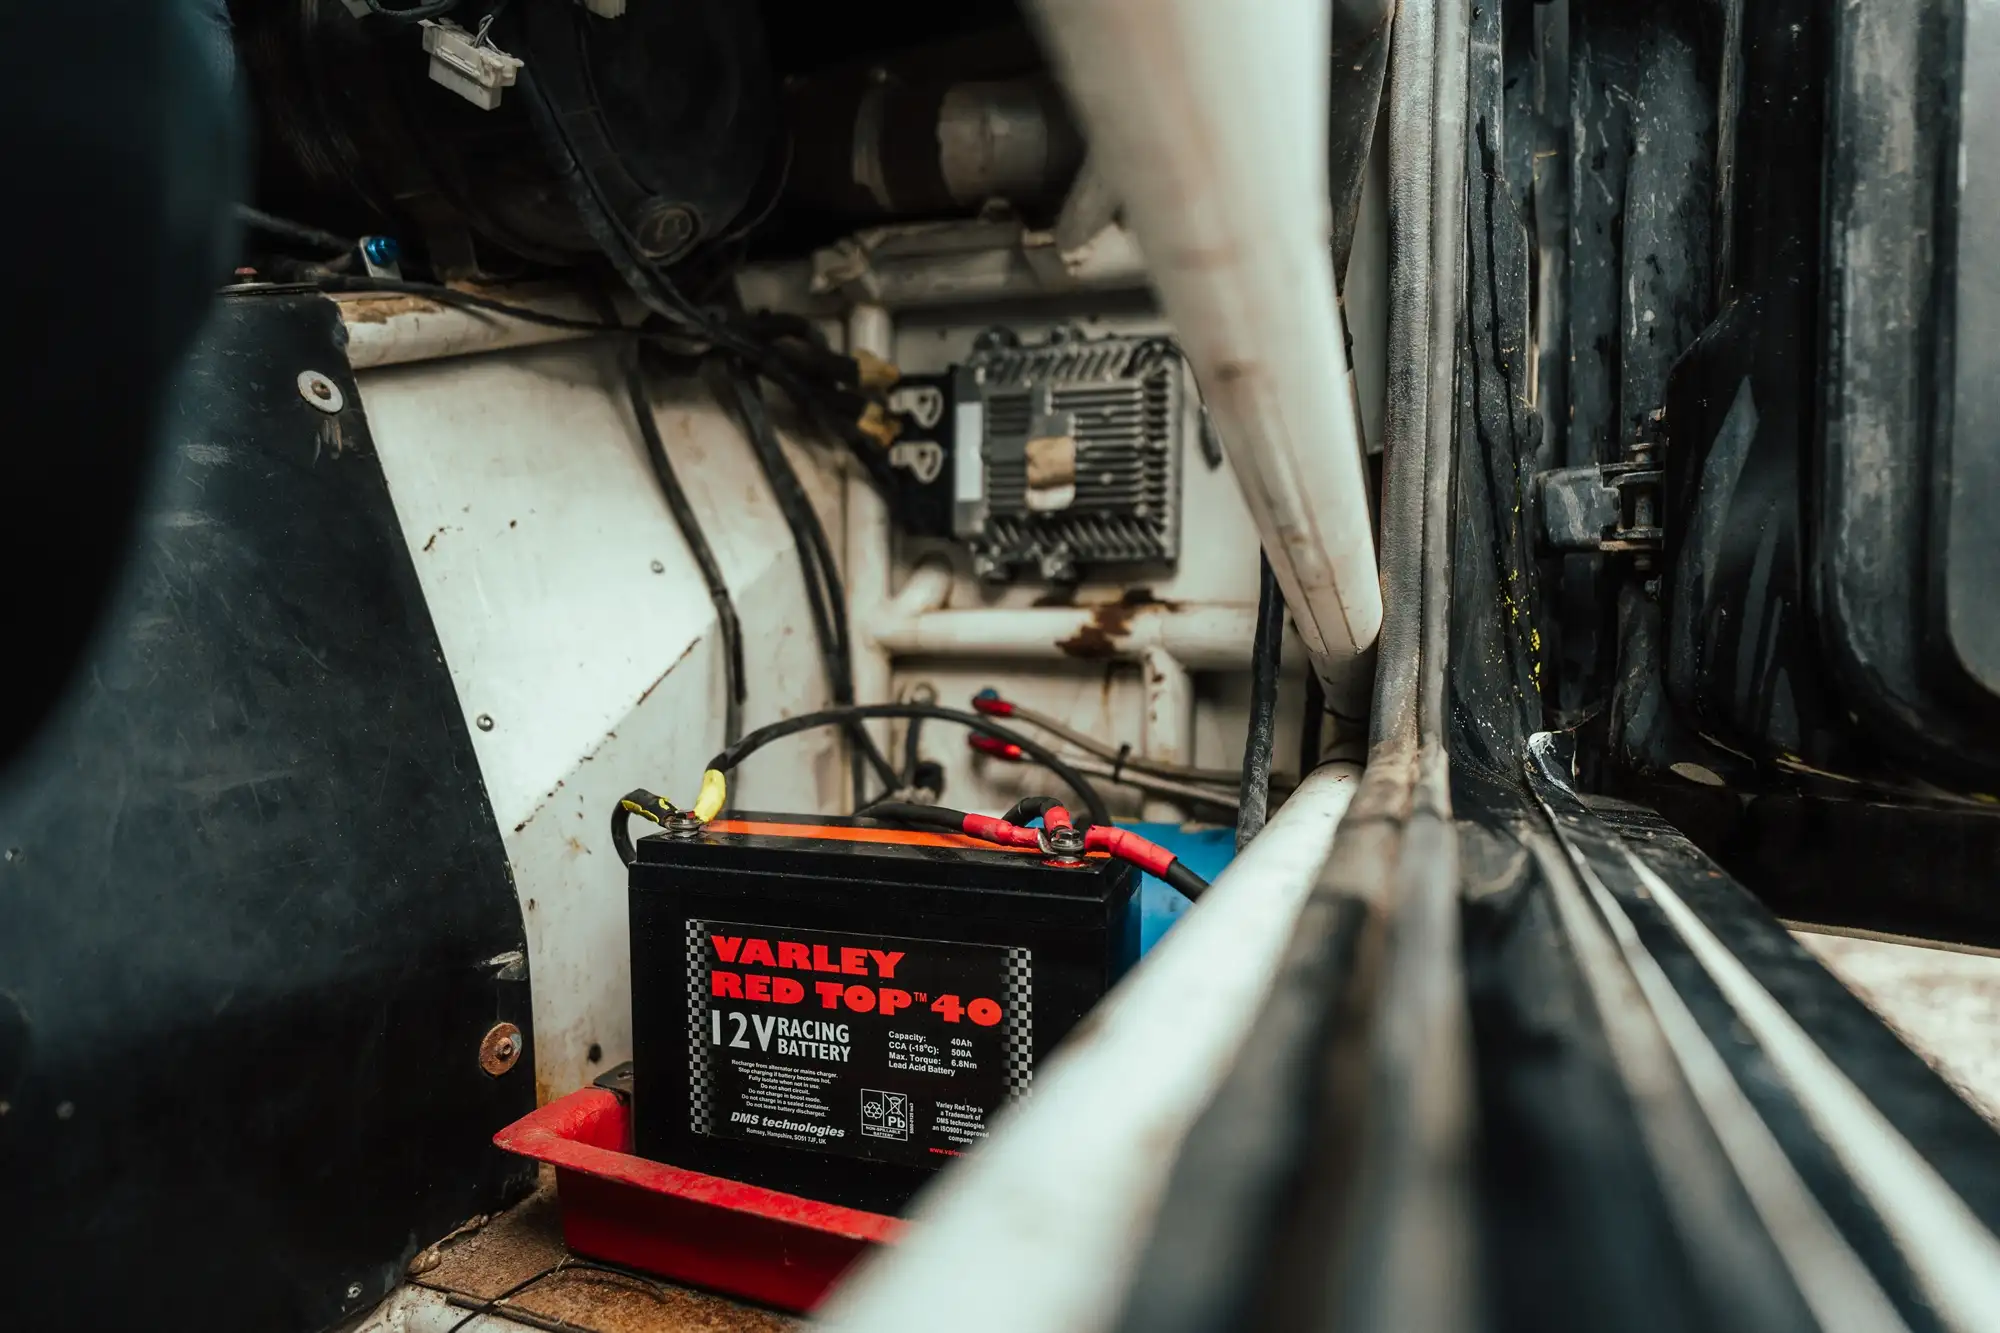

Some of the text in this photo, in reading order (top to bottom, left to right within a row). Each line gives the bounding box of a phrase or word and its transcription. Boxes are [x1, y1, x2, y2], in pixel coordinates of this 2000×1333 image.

[711, 935, 905, 979] VARLEY
[711, 970, 805, 1005] RED
[815, 981, 912, 1015] TOP
[930, 993, 1002, 1026] 40
[712, 1009, 776, 1052] 12V
[777, 1017, 850, 1043] RACING
[888, 1031, 973, 1047] Capacity: 40Ah
[777, 1038, 851, 1062] BATTERY
[888, 1041, 907, 1051] CCA
[951, 1048, 972, 1058] 500A
[731, 1059, 755, 1069] Recharge
[768, 1064, 793, 1072] alternator
[888, 1051, 978, 1069] Max. Torque: 6.8Nm
[888, 1060, 956, 1077] Lead Acid Battery
[748, 1075, 761, 1083] Fully
[762, 1076, 778, 1084] isolate
[750, 1069, 773, 1077] charging
[778, 1072, 796, 1080] battery
[796, 1074, 820, 1083] becomes
[765, 1090, 783, 1098] charge
[778, 1085, 792, 1093] short
[759, 1096, 776, 1104] charge
[777, 1105, 796, 1114] battery
[935, 1101, 953, 1110] Varley
[954, 1103, 965, 1111] Red
[966, 1105, 977, 1114] Top
[887, 1115, 906, 1129] Pb
[945, 1110, 974, 1120] Trademark
[730, 1111, 845, 1138] DMS technologies
[936, 1117, 985, 1130] DMS technologies
[948, 1135, 973, 1144] company
[963, 1129, 990, 1138] approved
